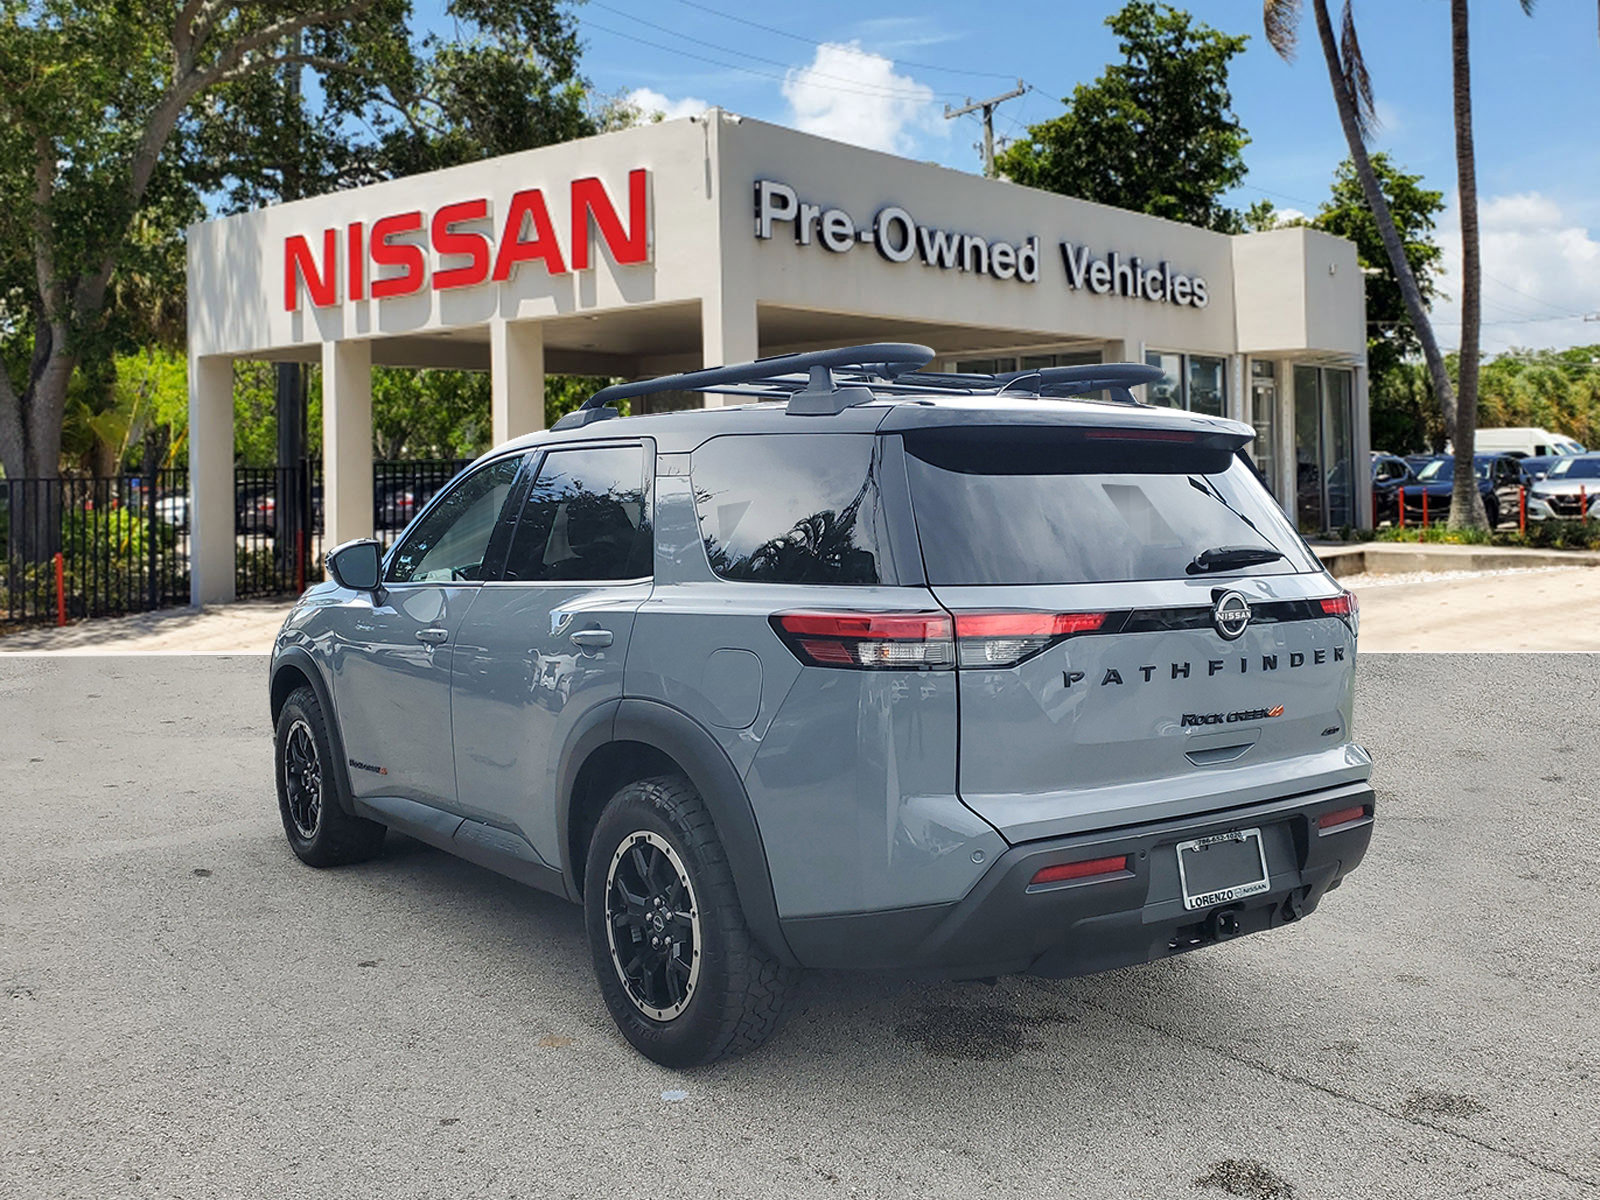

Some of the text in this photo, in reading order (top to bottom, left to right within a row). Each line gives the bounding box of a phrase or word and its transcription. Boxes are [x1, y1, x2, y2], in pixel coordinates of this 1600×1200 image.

[284, 168, 648, 312] NISSAN
[754, 179, 1209, 308] Pre-Owned Vehicles
[1215, 609, 1252, 621] NISSAN
[1062, 646, 1346, 688] PATHFINDER
[1189, 884, 1267, 908] LORENZO NISSAN
